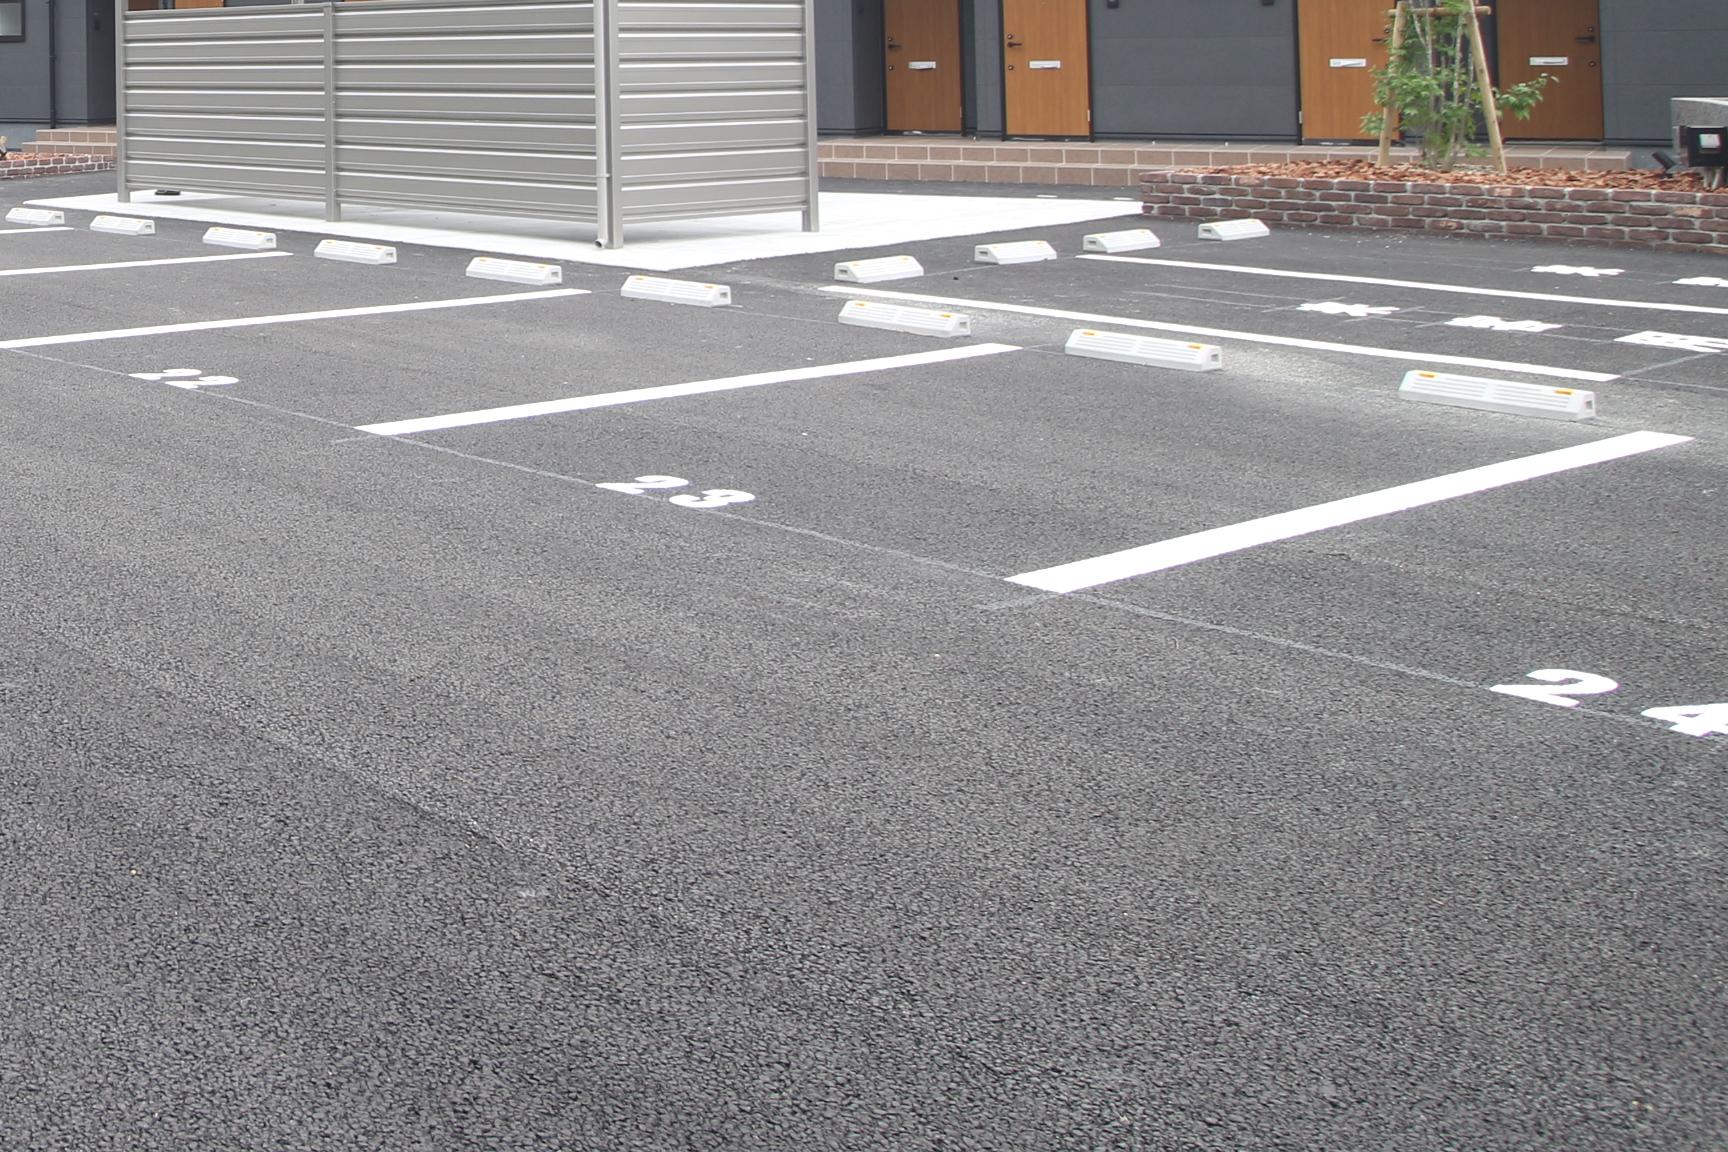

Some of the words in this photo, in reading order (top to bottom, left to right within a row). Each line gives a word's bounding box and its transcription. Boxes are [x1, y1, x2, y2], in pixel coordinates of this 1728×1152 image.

[127, 368, 240, 390] 22
[594, 474, 756, 509] 23
[1488, 668, 1728, 737] 24
